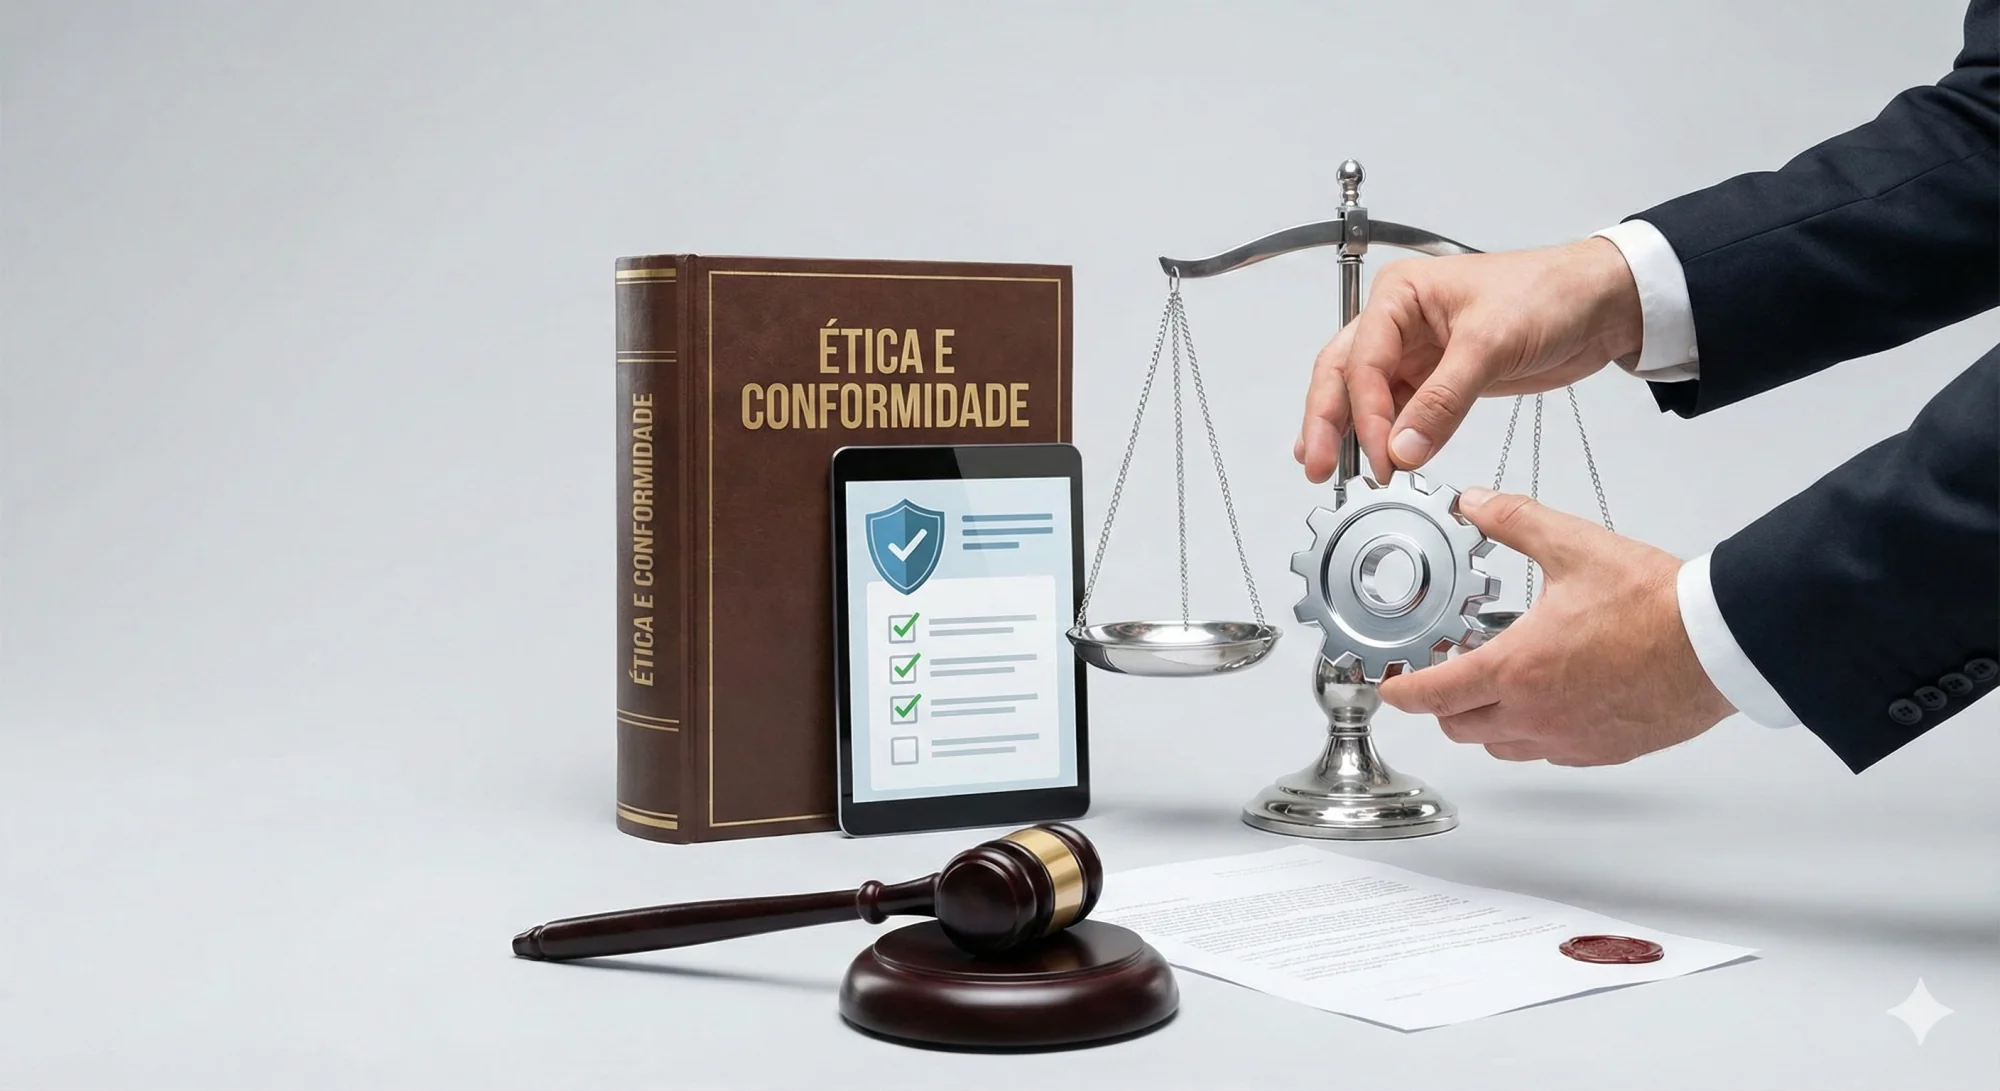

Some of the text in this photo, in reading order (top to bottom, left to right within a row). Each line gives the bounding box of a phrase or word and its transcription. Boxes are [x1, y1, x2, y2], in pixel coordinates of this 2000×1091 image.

[818, 318, 955, 375] ÉTICA E
[741, 382, 1030, 430] CONFORMIDADE
[629, 393, 654, 687] ÉTICA E CONFORMIDADE
